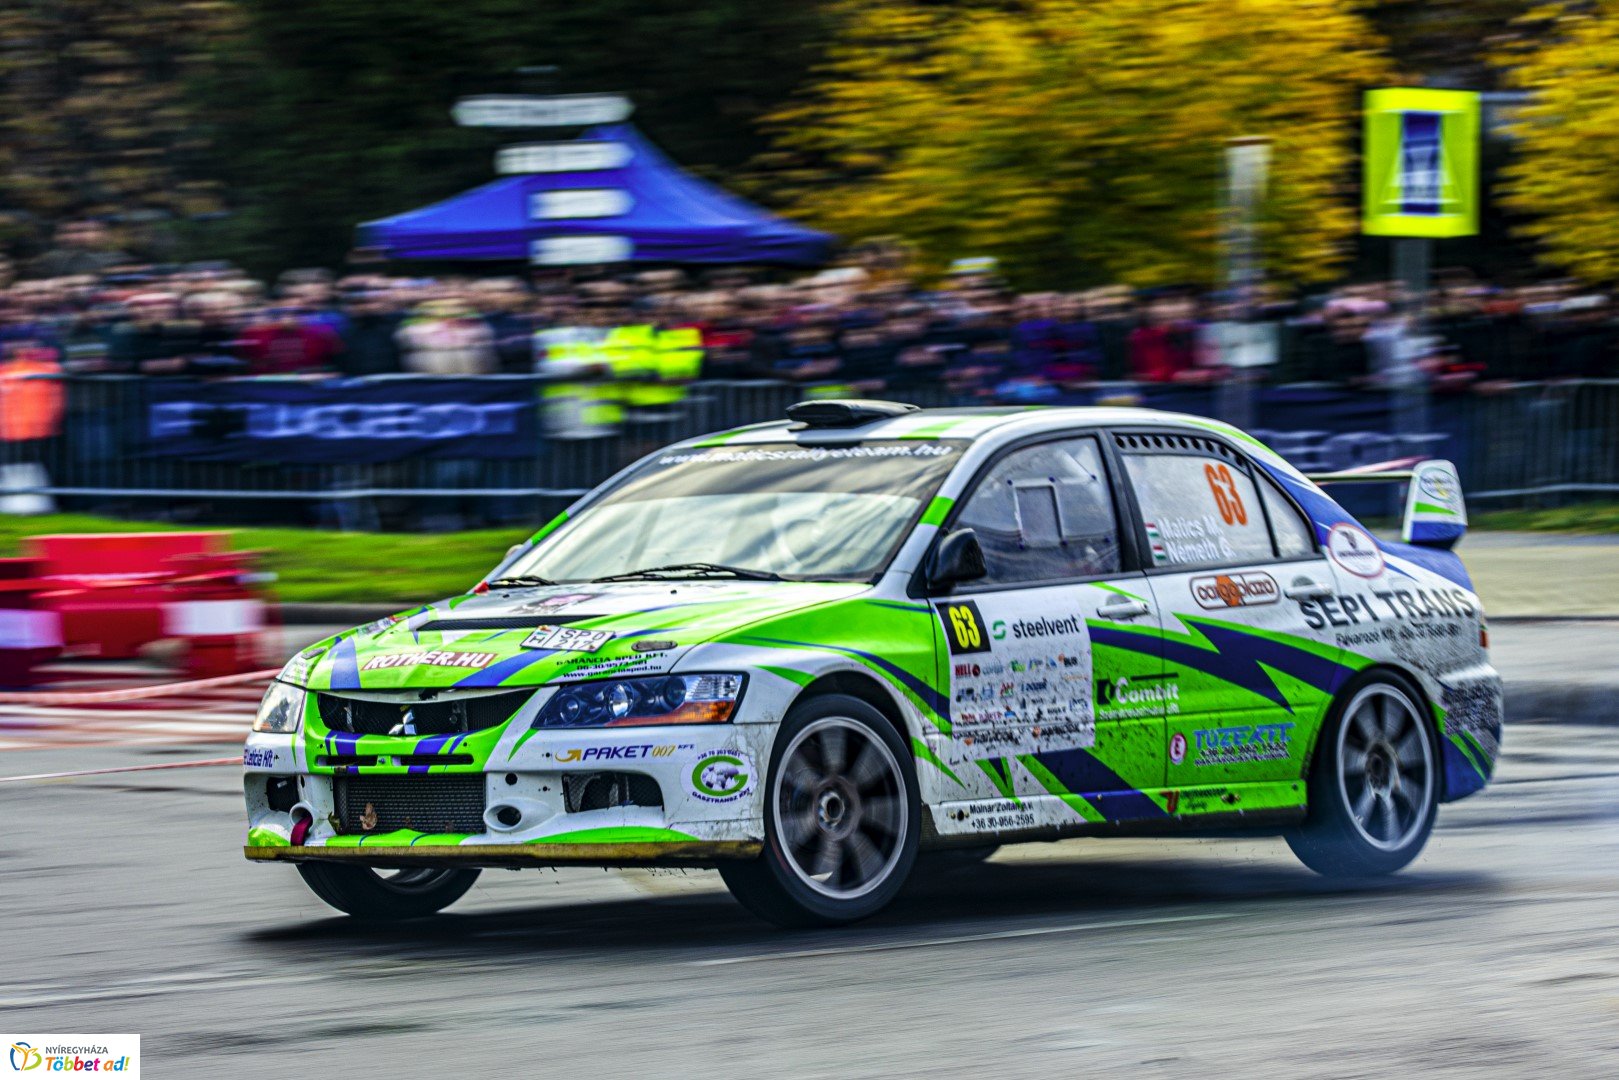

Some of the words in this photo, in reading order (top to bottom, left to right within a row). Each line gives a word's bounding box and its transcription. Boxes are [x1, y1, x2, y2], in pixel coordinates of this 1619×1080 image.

[1203, 462, 1248, 527] 63
[1299, 593, 1379, 630] SEPI
[1375, 588, 1475, 619] TRANS
[948, 605, 981, 649] 63
[1012, 614, 1080, 639] steelvent
[363, 651, 494, 670] ROTHER.HU
[582, 745, 654, 761] PAKET
